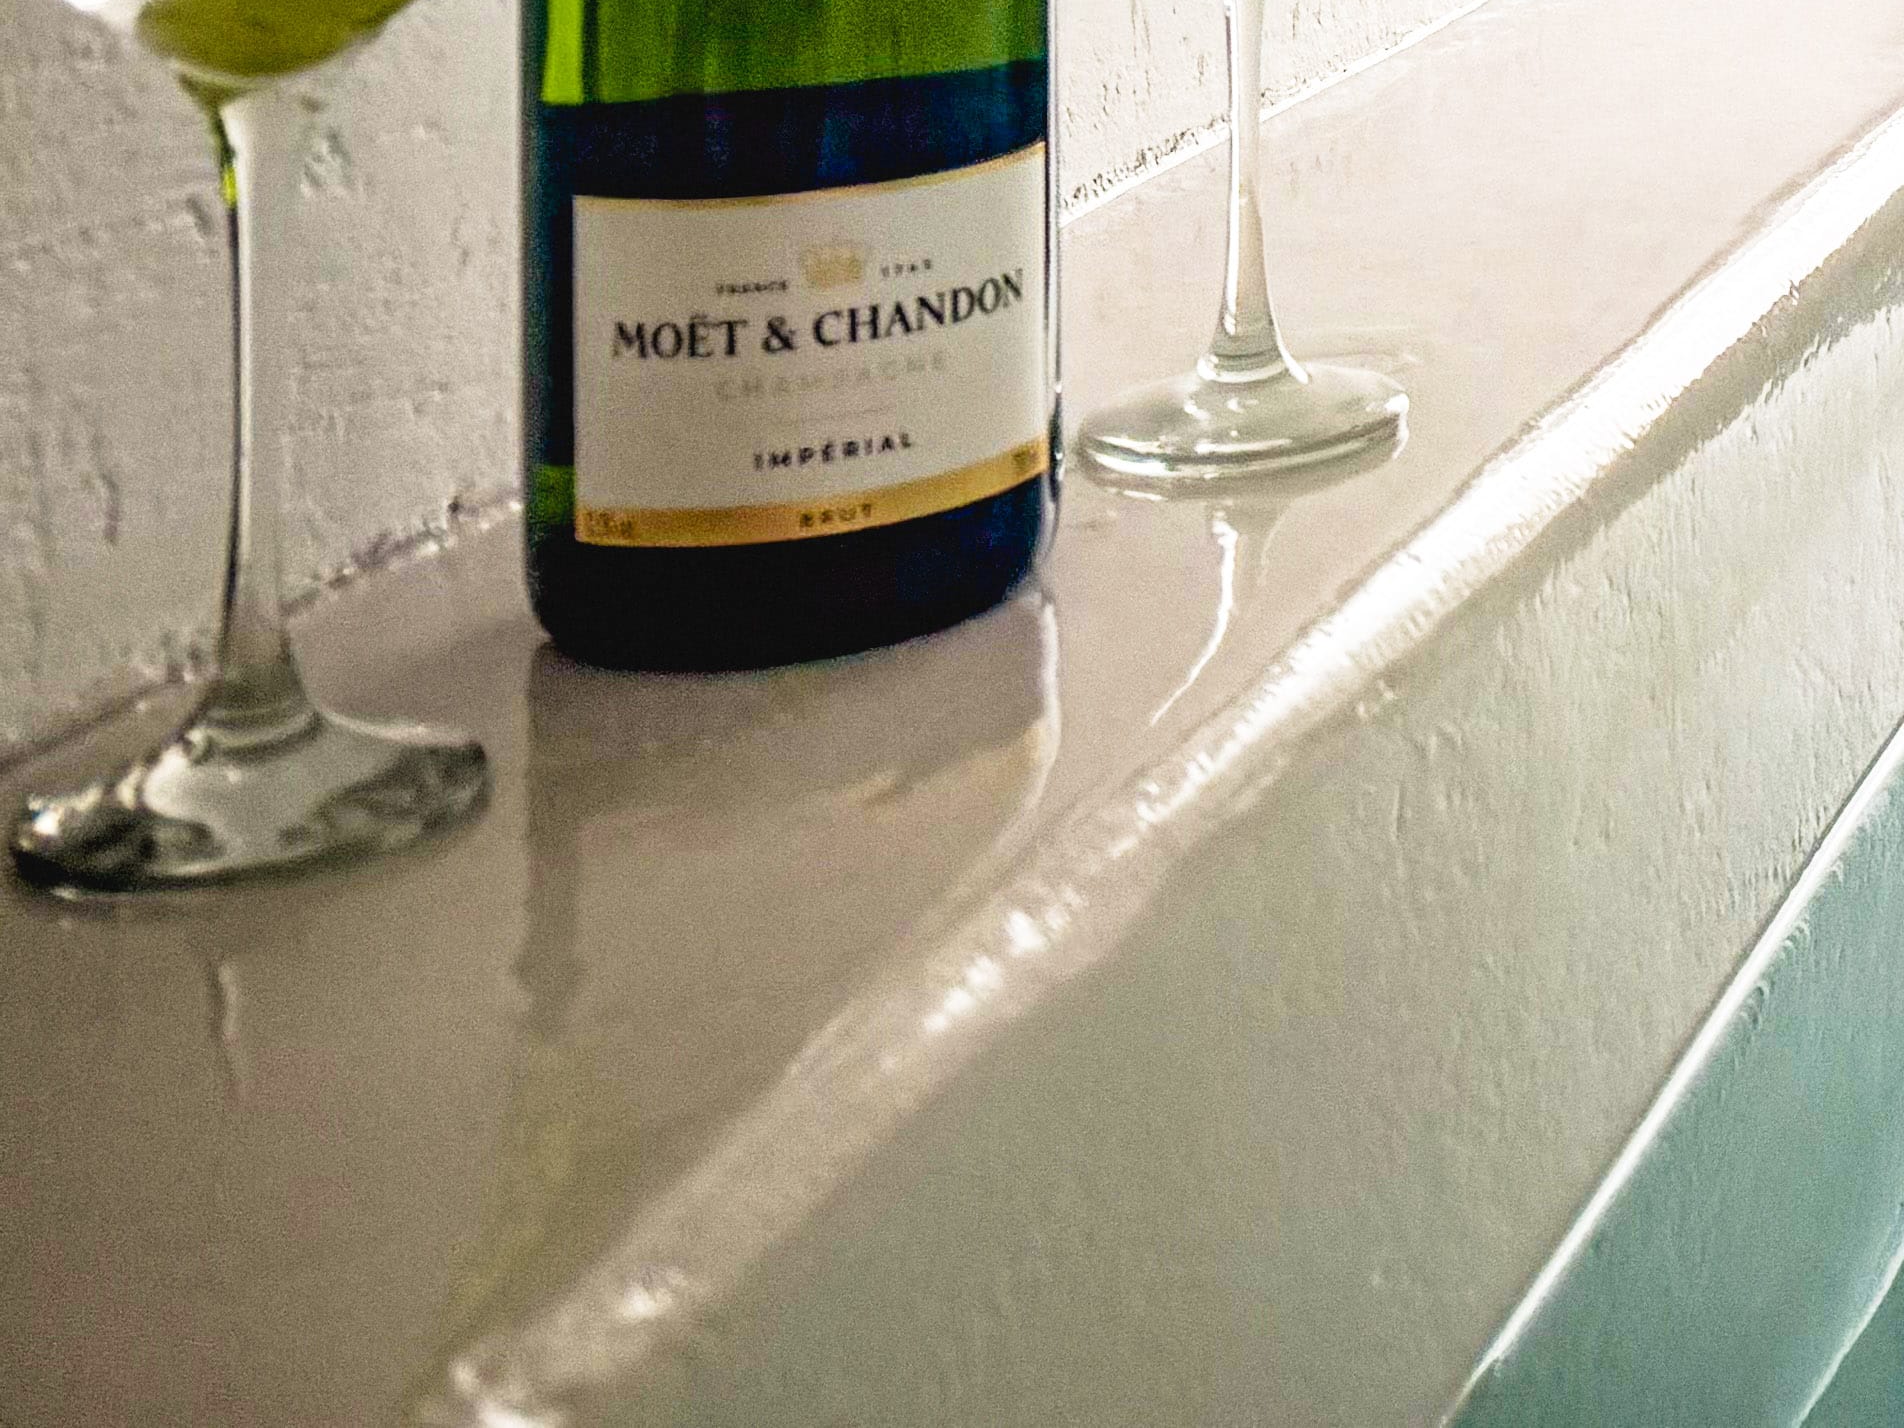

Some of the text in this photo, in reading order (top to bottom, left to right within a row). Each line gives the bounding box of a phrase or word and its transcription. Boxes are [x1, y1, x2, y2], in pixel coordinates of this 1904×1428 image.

[612, 267, 1024, 360] MOËT & CHANDON
[752, 432, 913, 471] IMPÉRIAL
[800, 502, 873, 528] BRUT
